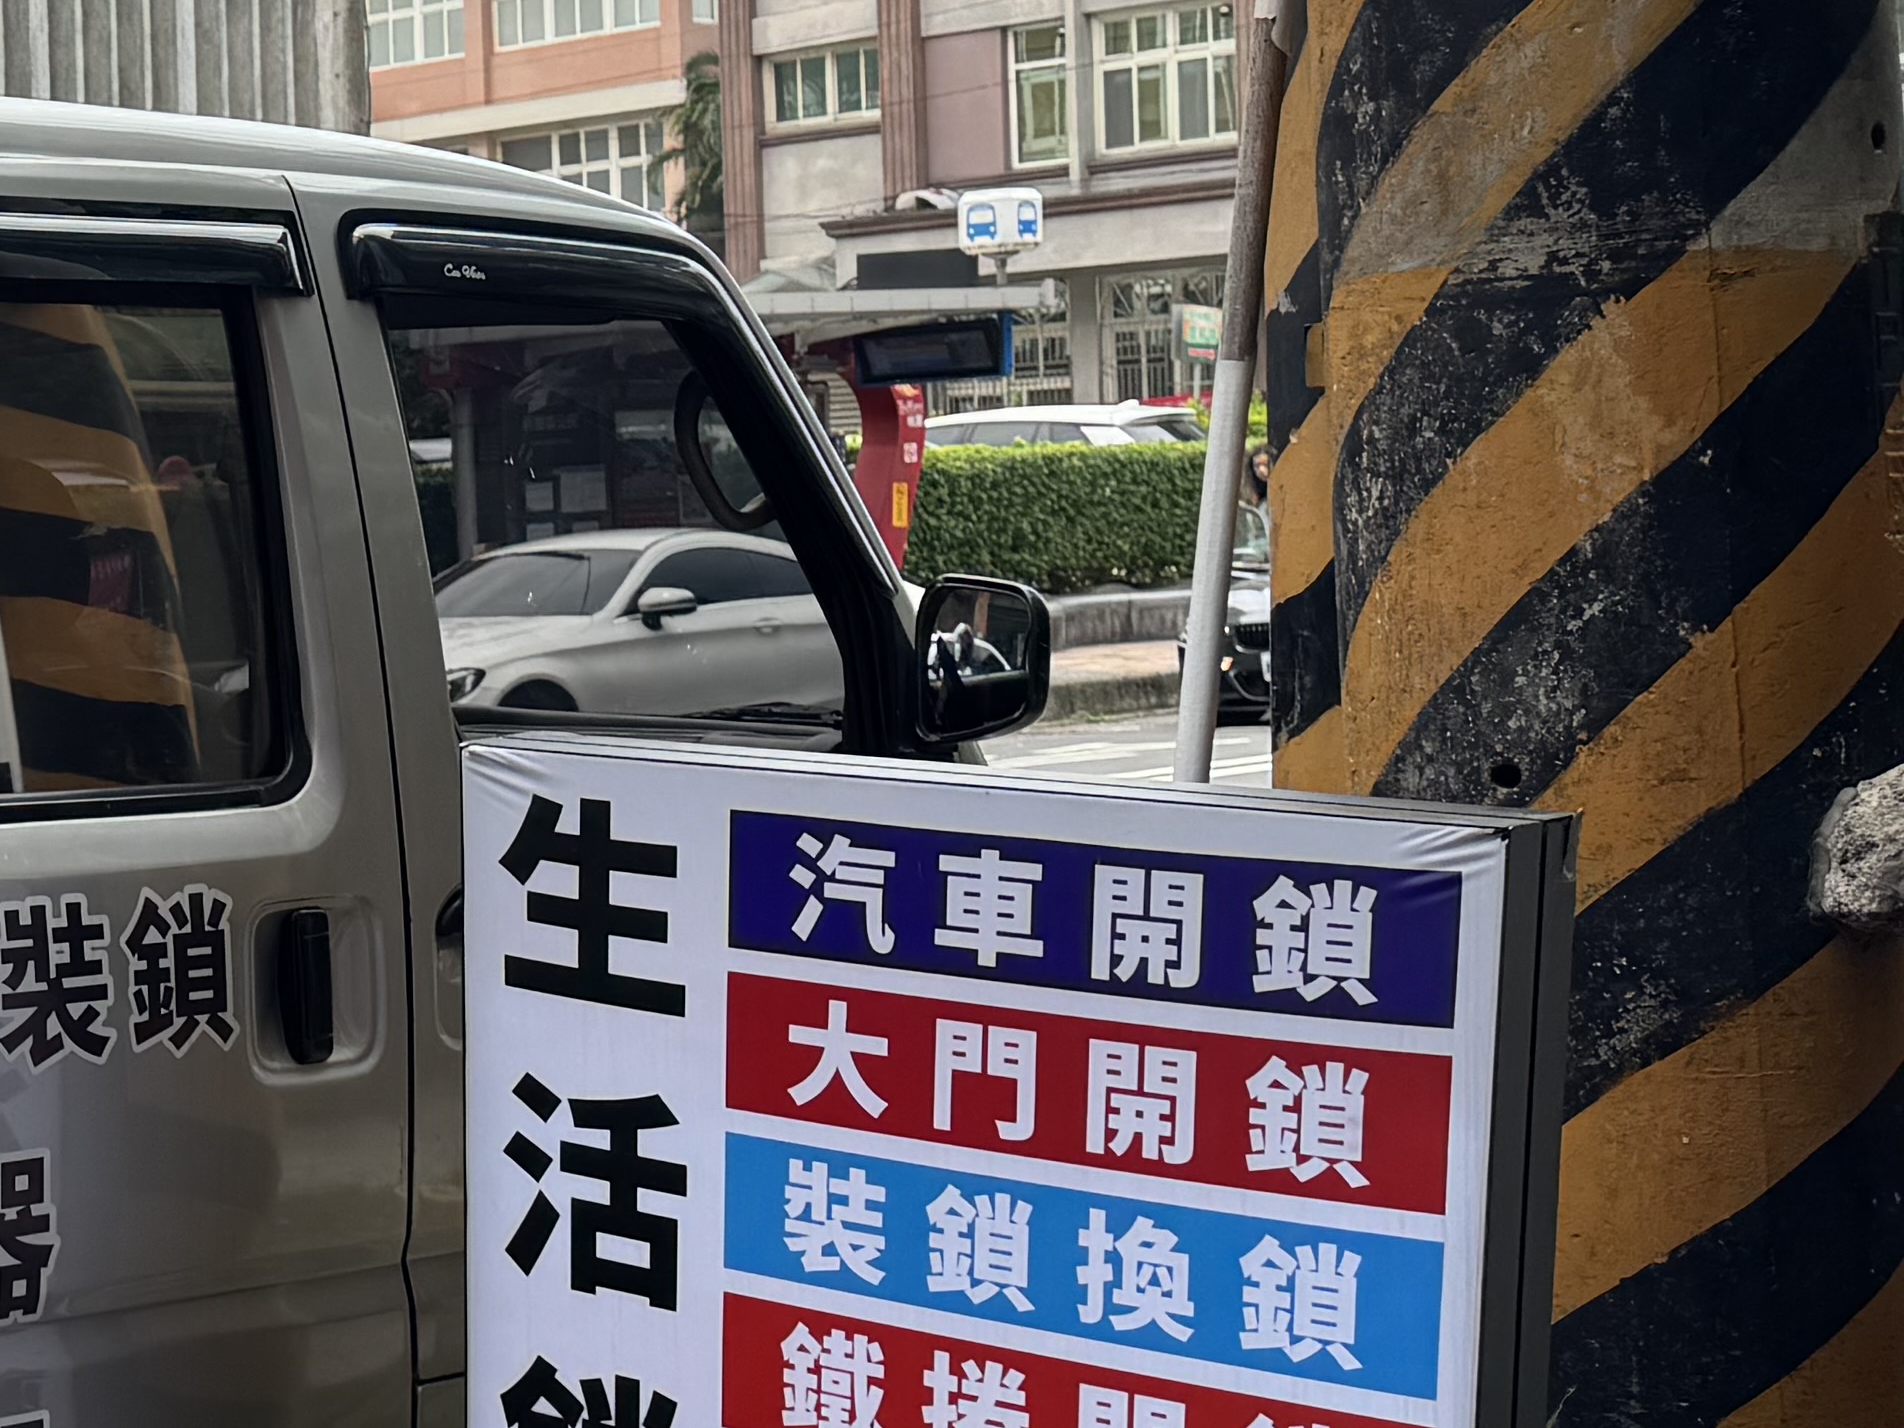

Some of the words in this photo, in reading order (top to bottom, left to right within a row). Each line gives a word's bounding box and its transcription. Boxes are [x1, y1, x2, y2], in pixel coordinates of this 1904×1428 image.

[787, 831, 1379, 1007] 汽車開鎖
[785, 998, 1371, 1189] 大門開鎖
[783, 1158, 1363, 1372] 裝鎖換鎖
